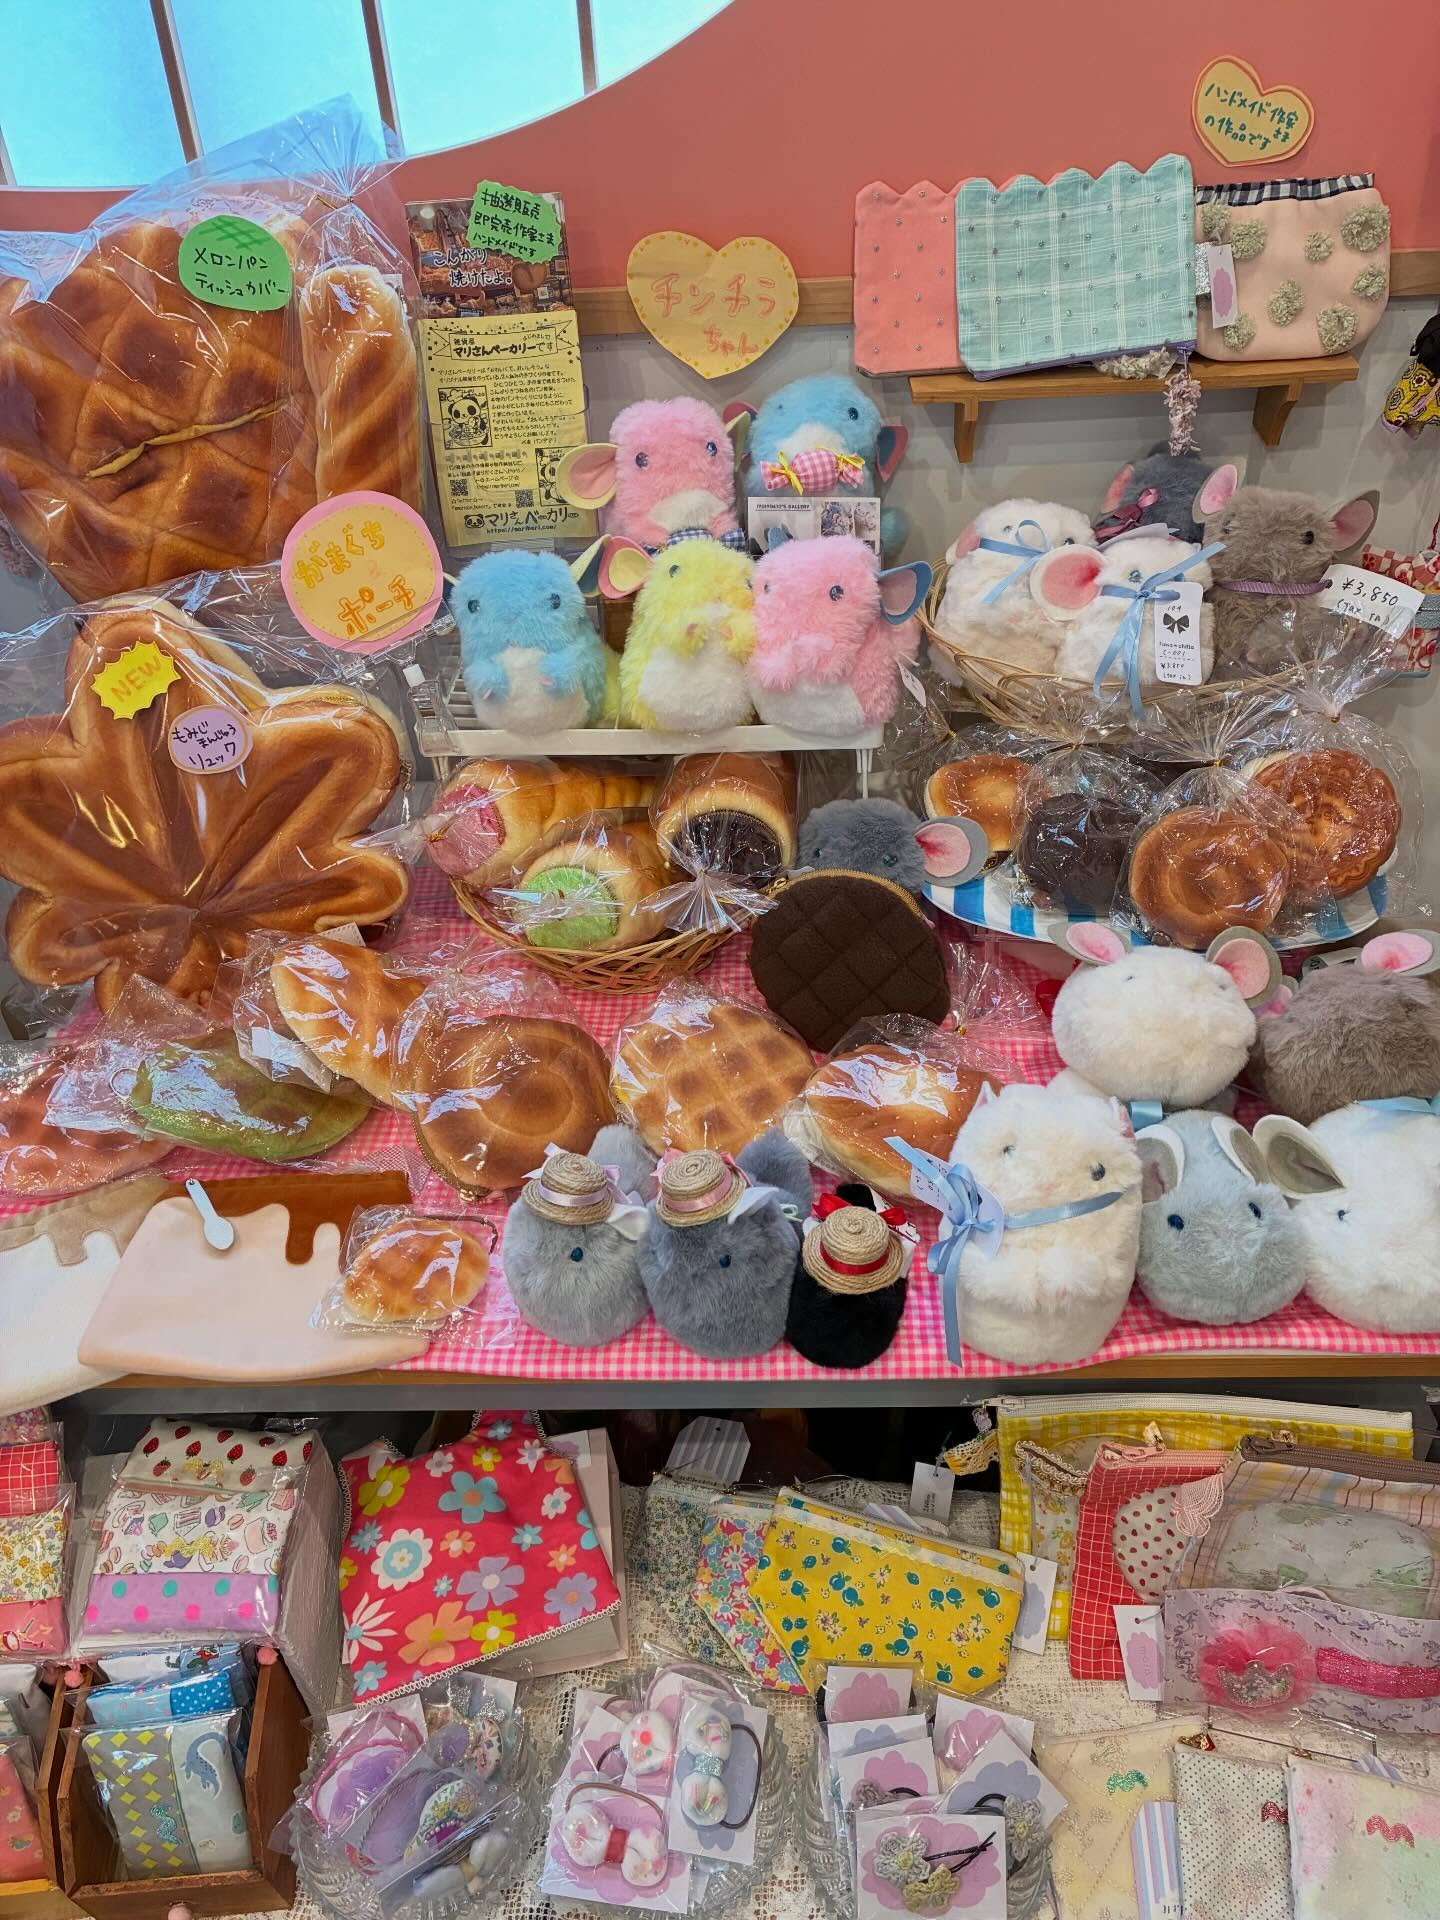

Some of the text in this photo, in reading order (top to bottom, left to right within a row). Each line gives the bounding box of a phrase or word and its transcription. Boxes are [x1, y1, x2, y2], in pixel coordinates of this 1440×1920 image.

[1205, 83, 1298, 129] ハンドメイド作家
[1204, 115, 1271, 150] の作品です
[481, 188, 541, 220] 抽選販売
[474, 211, 555, 246] 即完売作家さま
[194, 247, 268, 270] メロンパン
[433, 247, 488, 266] こんがり
[473, 232, 537, 257] ハンドメイドです
[195, 272, 287, 297] ティッシュカバー
[449, 268, 513, 287] 焼けたよ。
[651, 272, 775, 318] チンチラ
[704, 324, 760, 357] ちゃん
[296, 520, 385, 589] がまぐち
[338, 575, 416, 635] ポーチ
[1342, 577, 1398, 606] ¥3,850
[109, 655, 163, 703] NEW
[171, 721, 209, 743] もみじ
[197, 723, 237, 749] まんじゅう
[189, 742, 236, 770] リュック
